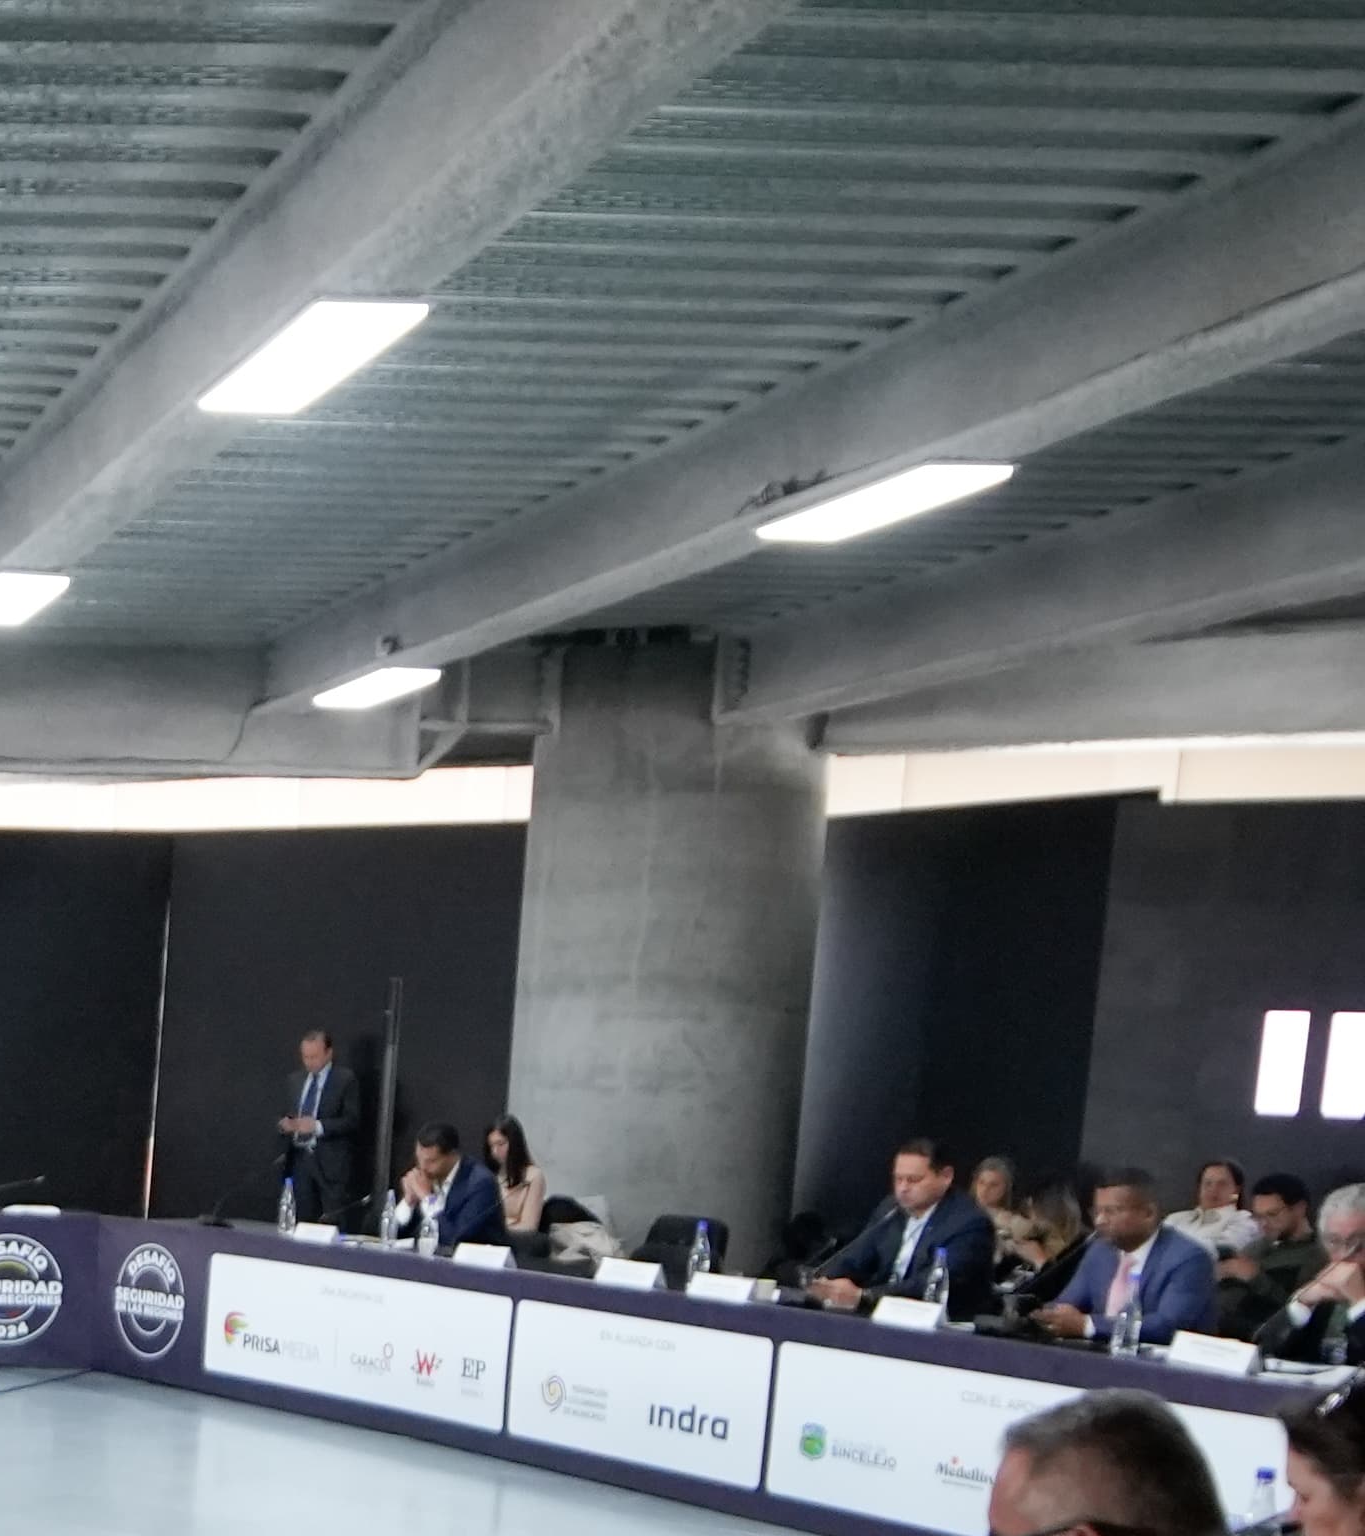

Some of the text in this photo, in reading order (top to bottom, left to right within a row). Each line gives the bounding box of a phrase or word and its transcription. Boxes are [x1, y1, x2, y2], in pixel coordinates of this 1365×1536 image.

[127, 1249, 177, 1283] DESAFÍO
[0, 1294, 62, 1306] REGIONES
[115, 1286, 185, 1311] SEGURIDAD
[243, 1333, 281, 1355] PRISA
[461, 1357, 486, 1381] EP
[648, 1403, 730, 1441] indra
